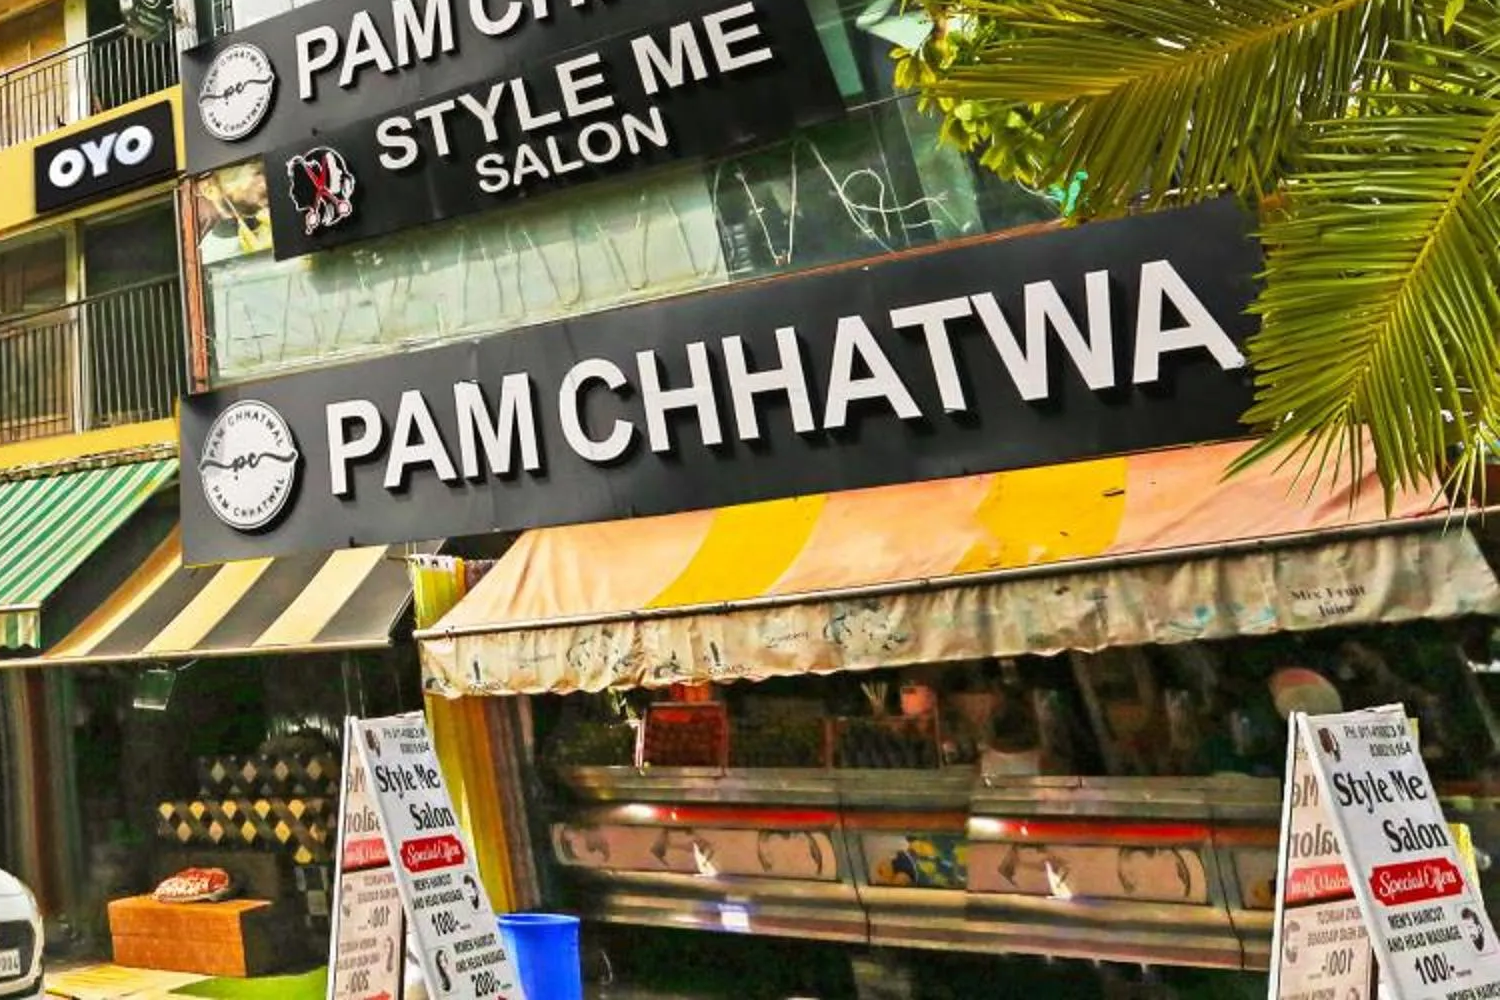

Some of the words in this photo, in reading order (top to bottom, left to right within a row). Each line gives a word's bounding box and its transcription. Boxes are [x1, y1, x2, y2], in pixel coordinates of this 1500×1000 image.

[377, 52, 617, 171] STYLE
[629, 1, 772, 95] ME
[48, 125, 153, 188] OYO
[476, 105, 670, 196] SALON
[325, 372, 540, 497] PAM
[557, 258, 1247, 463] CHHATWA
[376, 765, 417, 800] Style
[414, 764, 441, 789] Me
[1333, 771, 1394, 814] Style
[1388, 770, 1427, 801] Me
[409, 802, 455, 831] Salon
[1383, 817, 1449, 853] Salon
[1379, 868, 1425, 900] Special
[1415, 952, 1455, 985] 100/-
